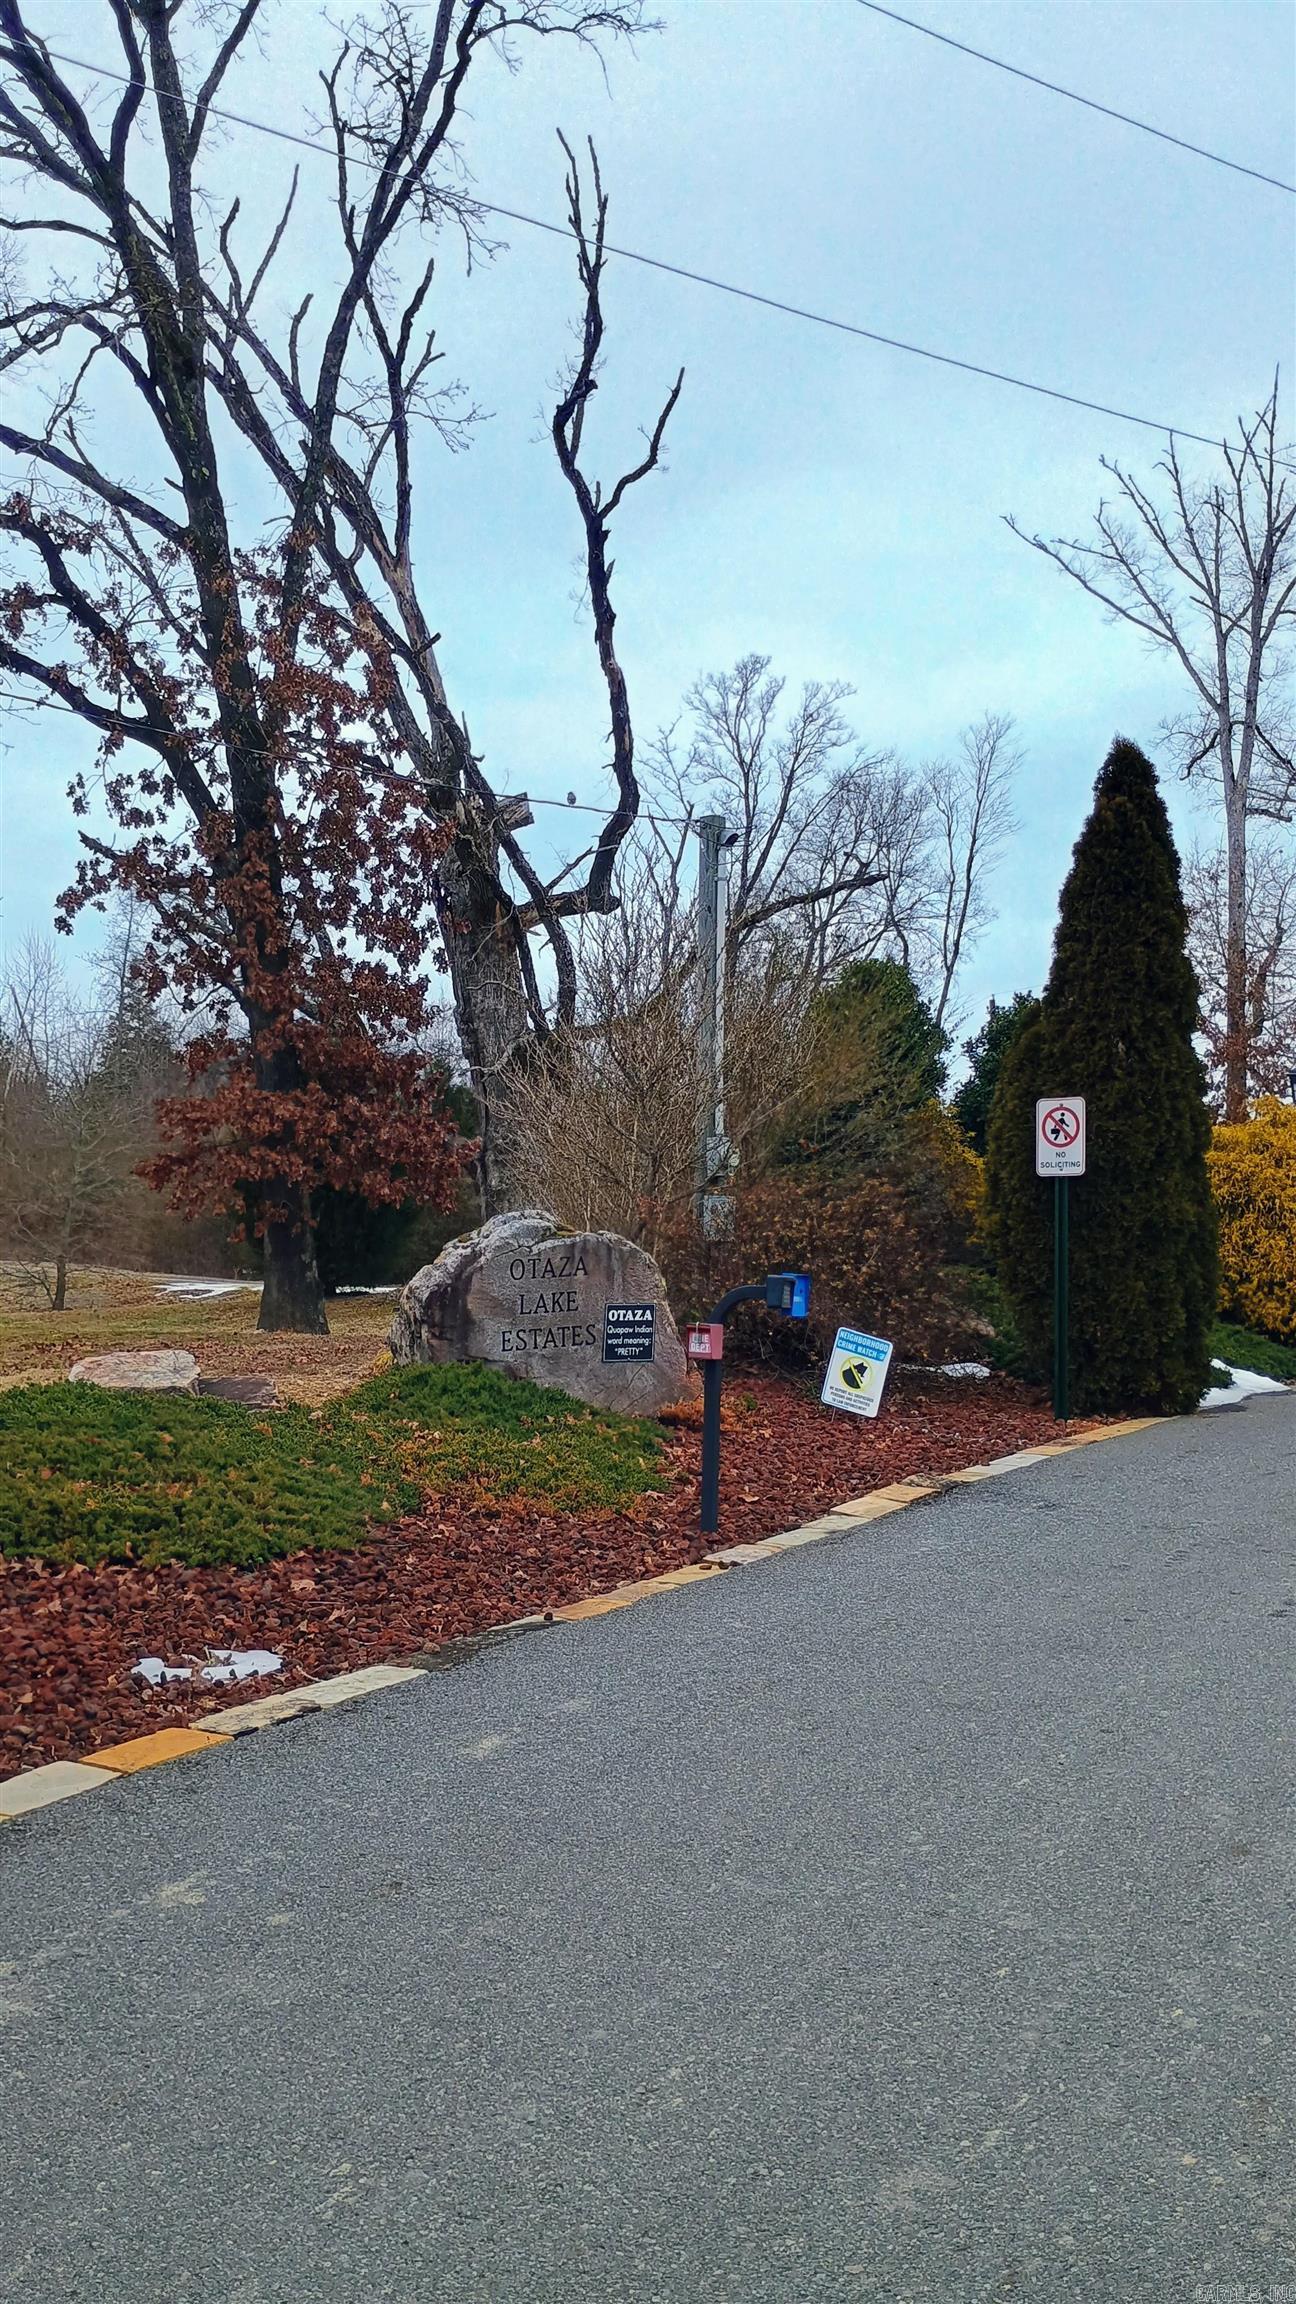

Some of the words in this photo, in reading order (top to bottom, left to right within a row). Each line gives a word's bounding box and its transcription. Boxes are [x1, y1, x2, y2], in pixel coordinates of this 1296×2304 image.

[510, 1255, 588, 1280] OTAZA
[519, 1290, 579, 1315] LAKE
[608, 1310, 652, 1321] OTAZA
[501, 1324, 597, 1352] ESTATES
[607, 1325, 634, 1335] Quapaw
[635, 1325, 653, 1333] Indian
[607, 1336, 623, 1344] word
[624, 1336, 652, 1346] meaning:
[838, 1339, 857, 1351] CRIME
[857, 1346, 877, 1358] WATCH
[840, 1330, 889, 1352] NEIGHBORHOOD
[614, 1347, 644, 1355] "PRETTY"
